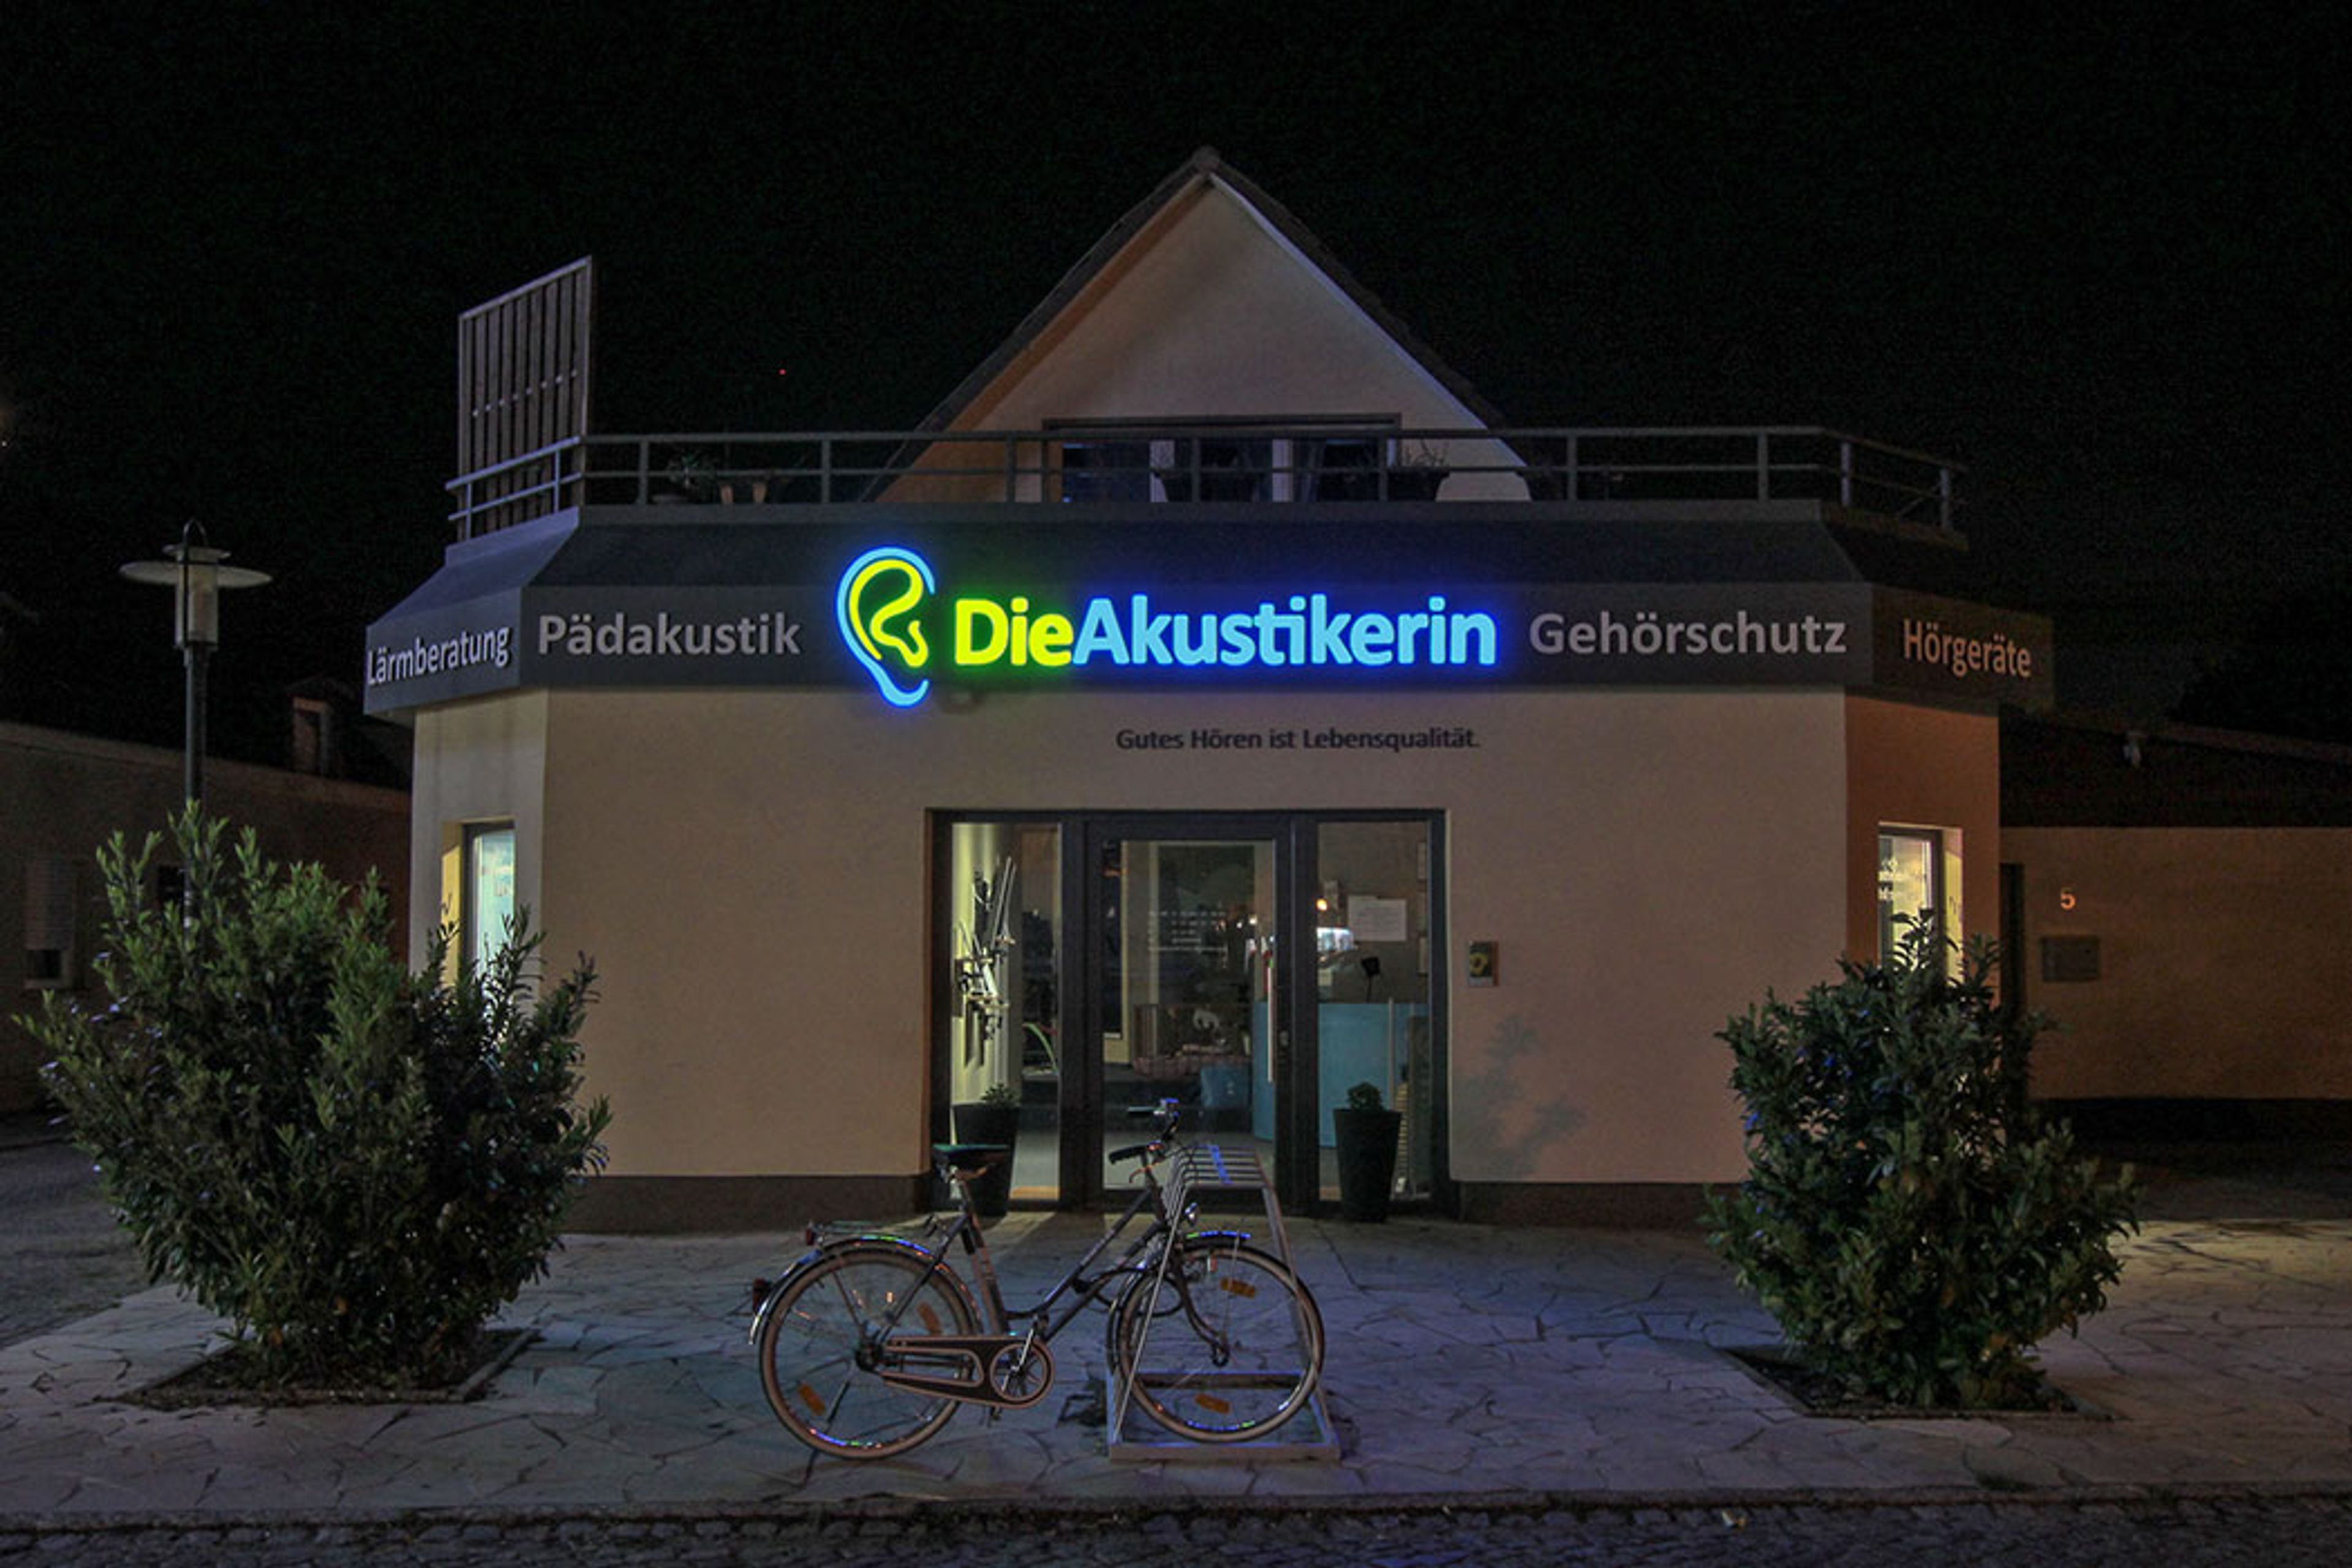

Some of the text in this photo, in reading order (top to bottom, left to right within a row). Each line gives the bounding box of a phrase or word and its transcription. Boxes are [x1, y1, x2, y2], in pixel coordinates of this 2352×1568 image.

[538, 612, 801, 655] Pädakustik
[954, 594, 1497, 666] DieAkustikerin
[1529, 610, 1848, 655] Gehörschutz
[1903, 619, 2032, 678] Hörgeräte
[368, 625, 510, 686] Lärmberatung
[1115, 727, 1479, 753] Gutes Hören ist Lebensqualität.
[2059, 888, 2077, 911] 5
